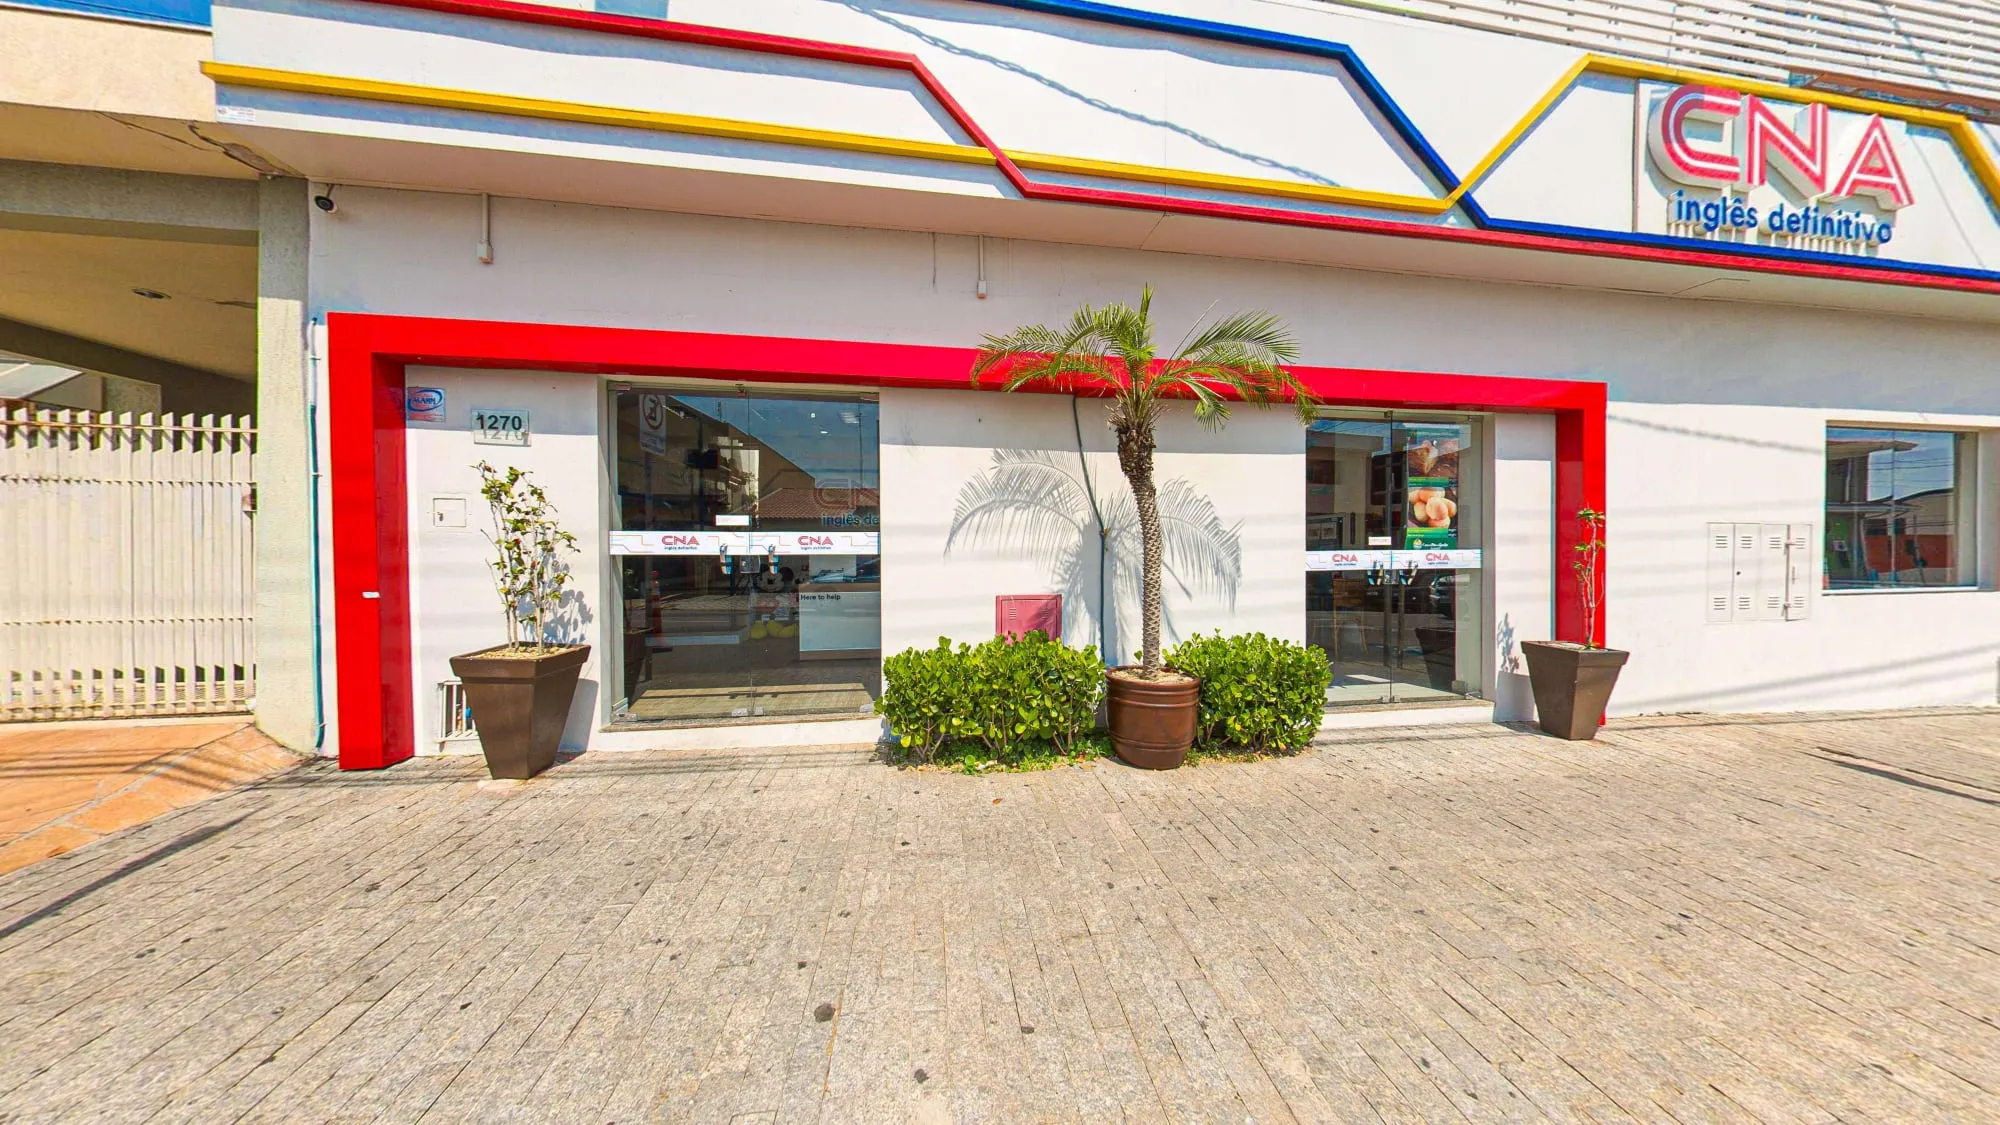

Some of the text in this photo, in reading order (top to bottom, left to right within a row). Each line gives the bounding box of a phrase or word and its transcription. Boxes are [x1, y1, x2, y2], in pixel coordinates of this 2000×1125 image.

[1661, 84, 1915, 206] CNA
[1675, 190, 1893, 244] inglês definitivo
[475, 412, 522, 430] 1270
[823, 512, 860, 528] inglês
[661, 535, 700, 546] CNA
[797, 535, 834, 546] CNA
[1332, 553, 1359, 563] CNA
[1425, 552, 1450, 562] CNA
[826, 593, 842, 601] help
